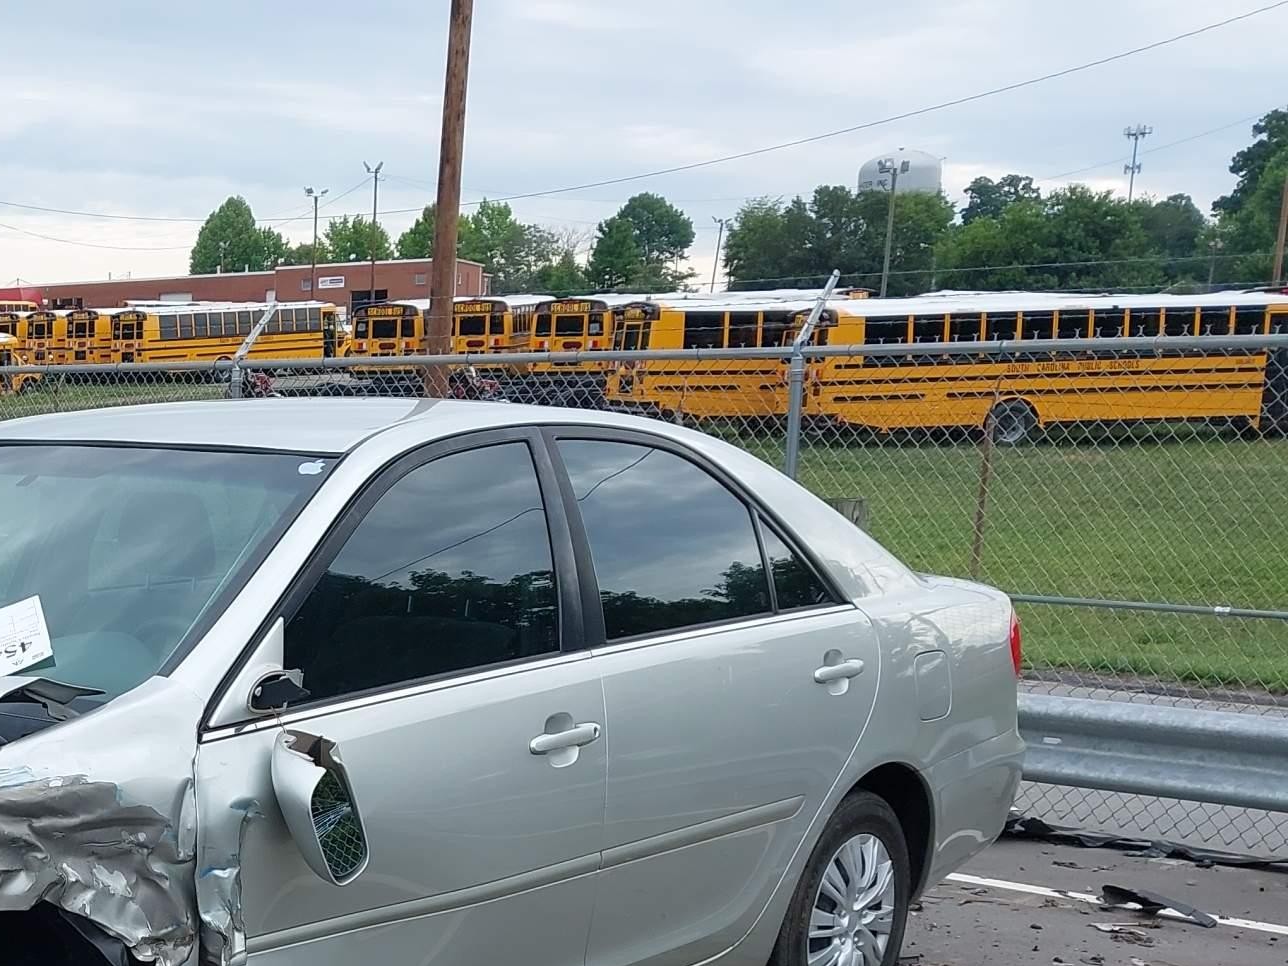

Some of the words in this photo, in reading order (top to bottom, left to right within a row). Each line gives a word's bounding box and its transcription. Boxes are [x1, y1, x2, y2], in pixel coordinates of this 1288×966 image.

[1007, 363, 1030, 373] SOUTH
[1037, 362, 1070, 372] CAROLINA
[1109, 360, 1140, 369] SCHOOLS
